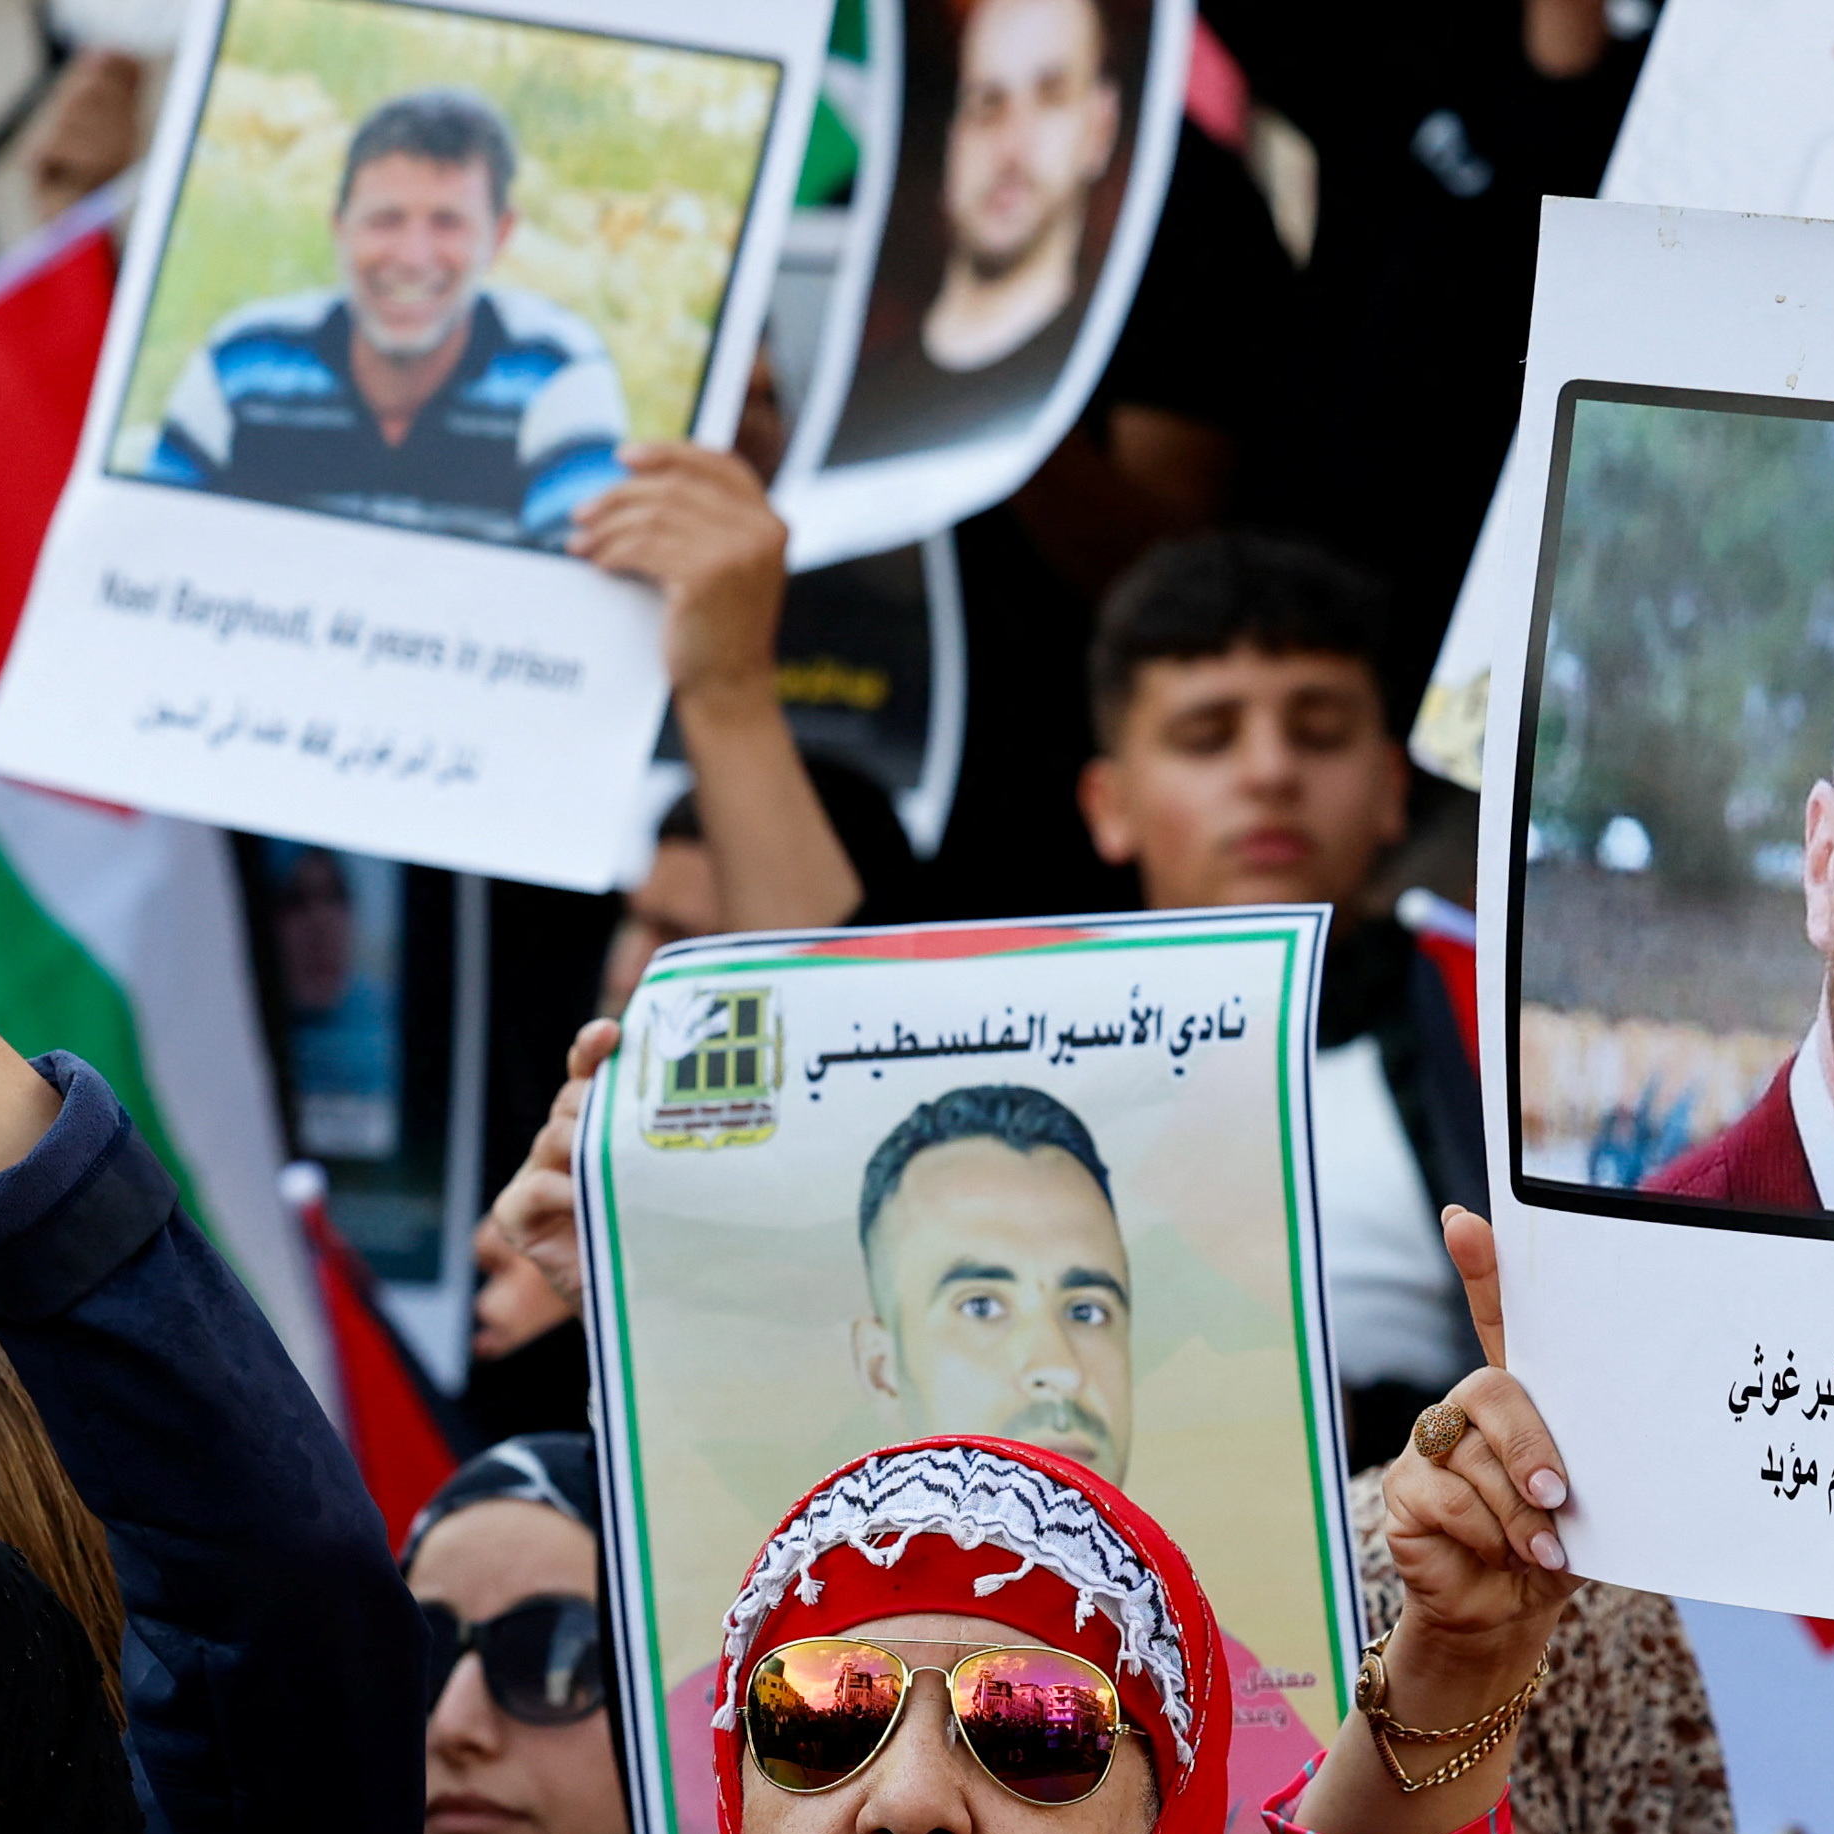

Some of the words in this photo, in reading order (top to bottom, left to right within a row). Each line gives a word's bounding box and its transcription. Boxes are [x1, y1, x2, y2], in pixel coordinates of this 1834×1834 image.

[806, 1005, 1046, 1100] الفلسطيني
[1050, 984, 1162, 1066] الأسير
[1168, 996, 1247, 1076] نادي
[1760, 1443, 1818, 1501] مؤبد
